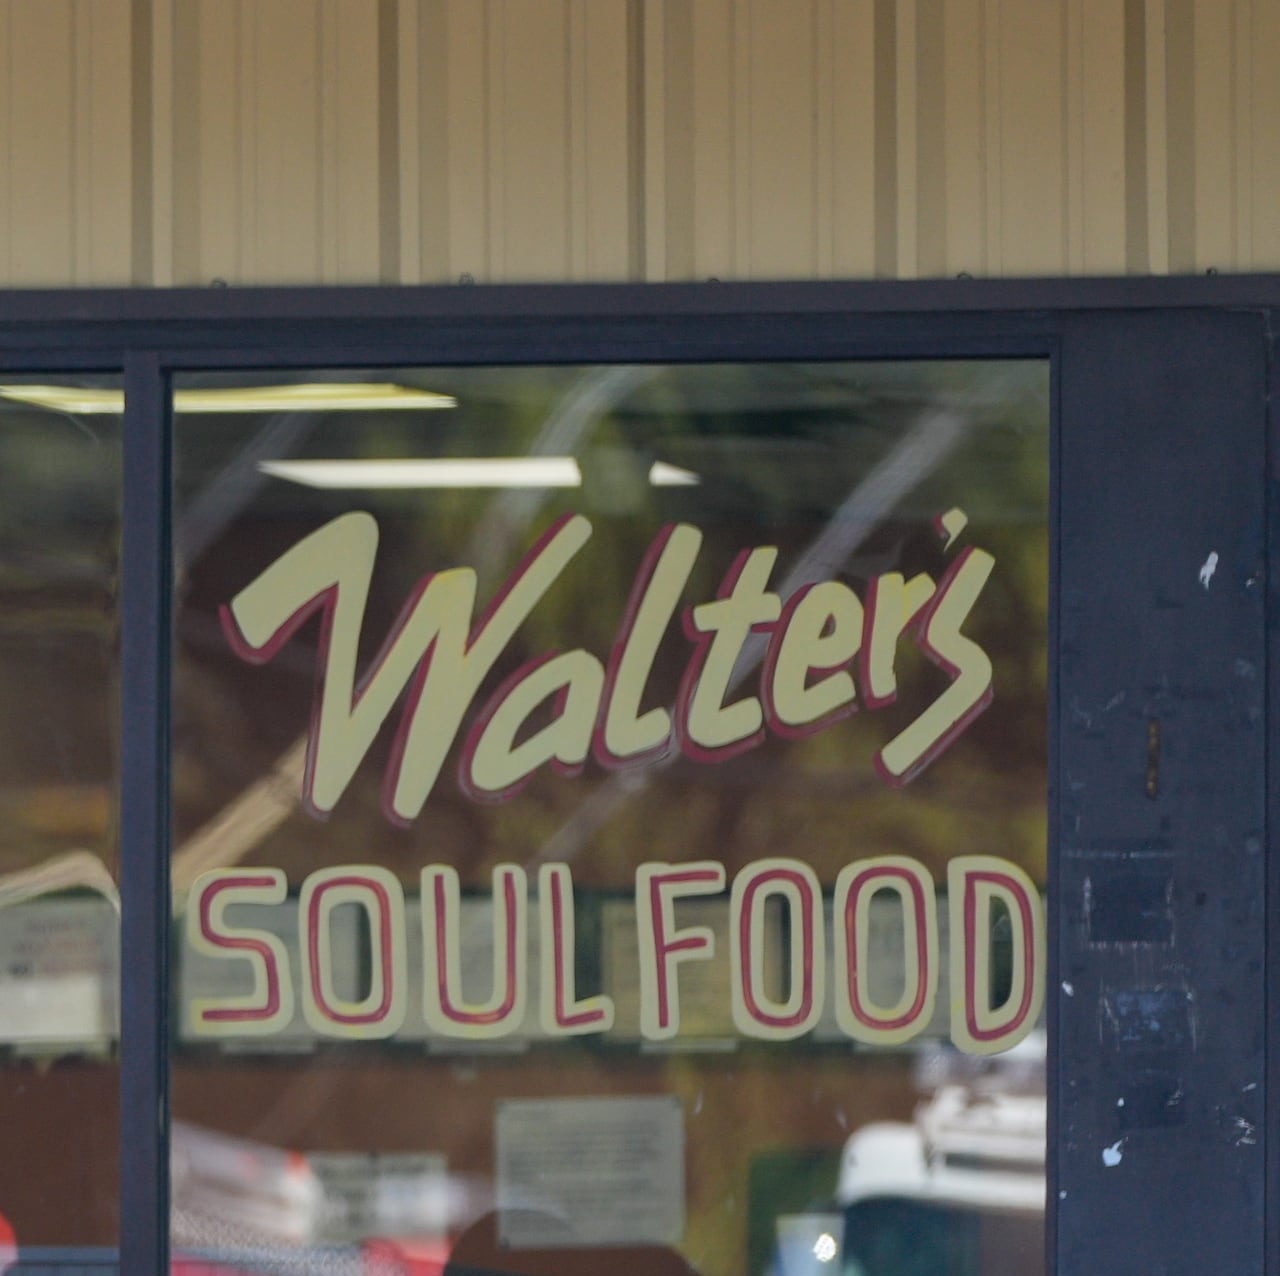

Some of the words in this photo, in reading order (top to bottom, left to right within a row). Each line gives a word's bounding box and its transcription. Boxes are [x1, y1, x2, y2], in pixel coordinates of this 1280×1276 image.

[218, 508, 996, 828] Walter's
[186, 862, 615, 1041] SOUL
[634, 855, 1042, 1054] FOOD
